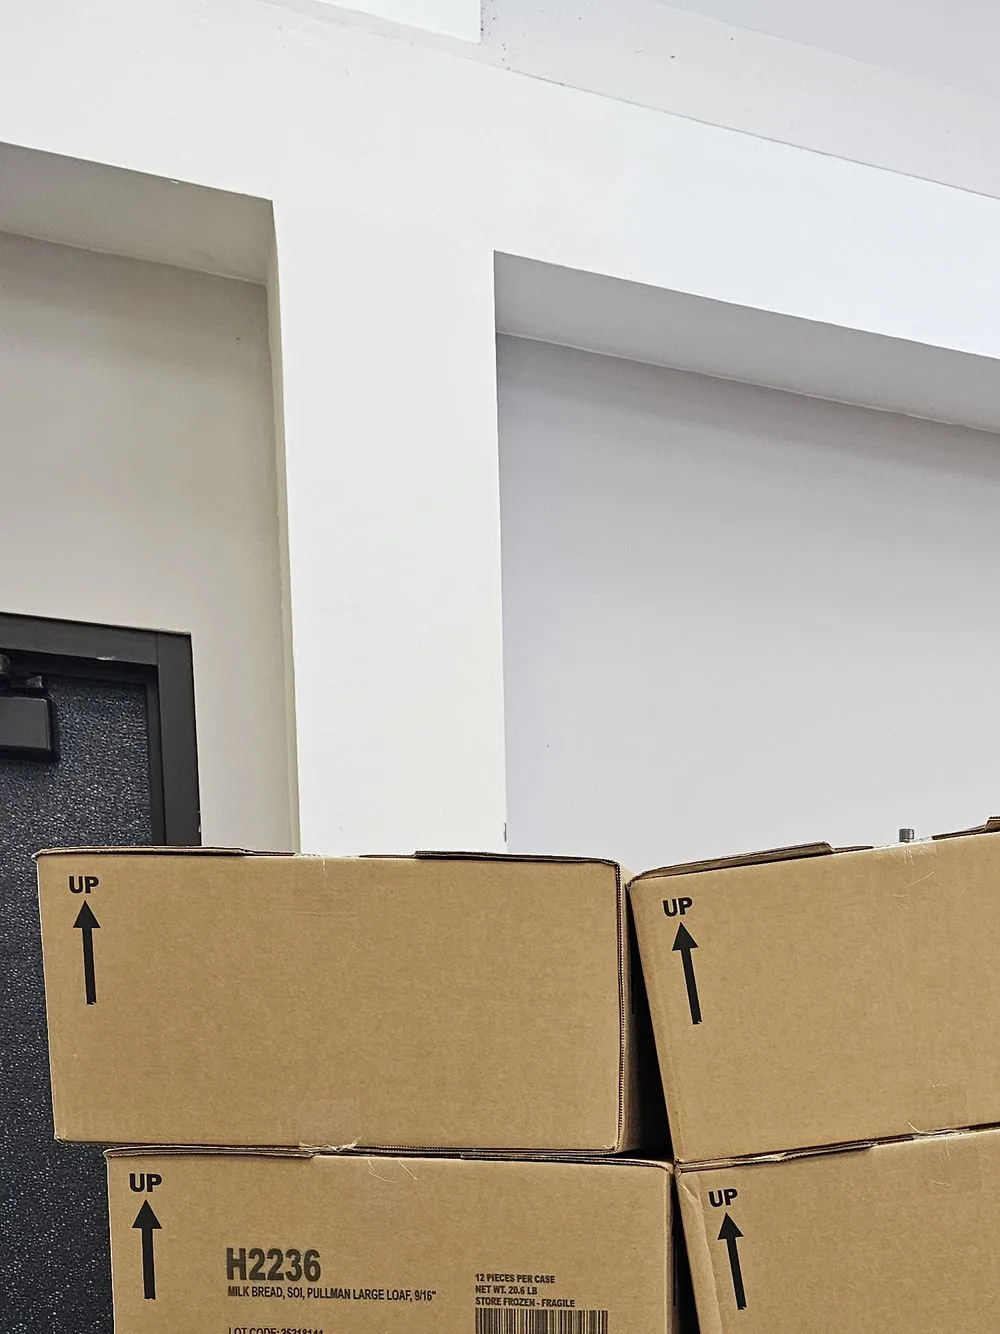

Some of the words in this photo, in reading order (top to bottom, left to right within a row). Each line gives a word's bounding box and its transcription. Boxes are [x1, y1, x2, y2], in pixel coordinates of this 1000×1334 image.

[69, 876, 99, 893] UP
[663, 898, 692, 916] UP
[130, 1174, 162, 1192] UP
[709, 1189, 737, 1207] UP
[226, 1247, 321, 1282] H2236
[475, 1274, 485, 1282] 12
[486, 1274, 515, 1283] PIECES
[517, 1275, 533, 1283] PER
[534, 1275, 556, 1284] CASE
[228, 1286, 250, 1297] MILK
[251, 1286, 285, 1299] BREAD,
[307, 1287, 351, 1300] PULLMAN
[353, 1289, 384, 1300] LARGE
[387, 1290, 413, 1302] LOAF,
[475, 1285, 491, 1294] NET
[493, 1285, 507, 1294] WT.
[508, 1286, 525, 1295] 20.6
[527, 1286, 538, 1295] LB
[475, 1297, 501, 1306] STORE
[503, 1298, 535, 1307] FROZEN
[541, 1298, 576, 1308] FRAGILE
